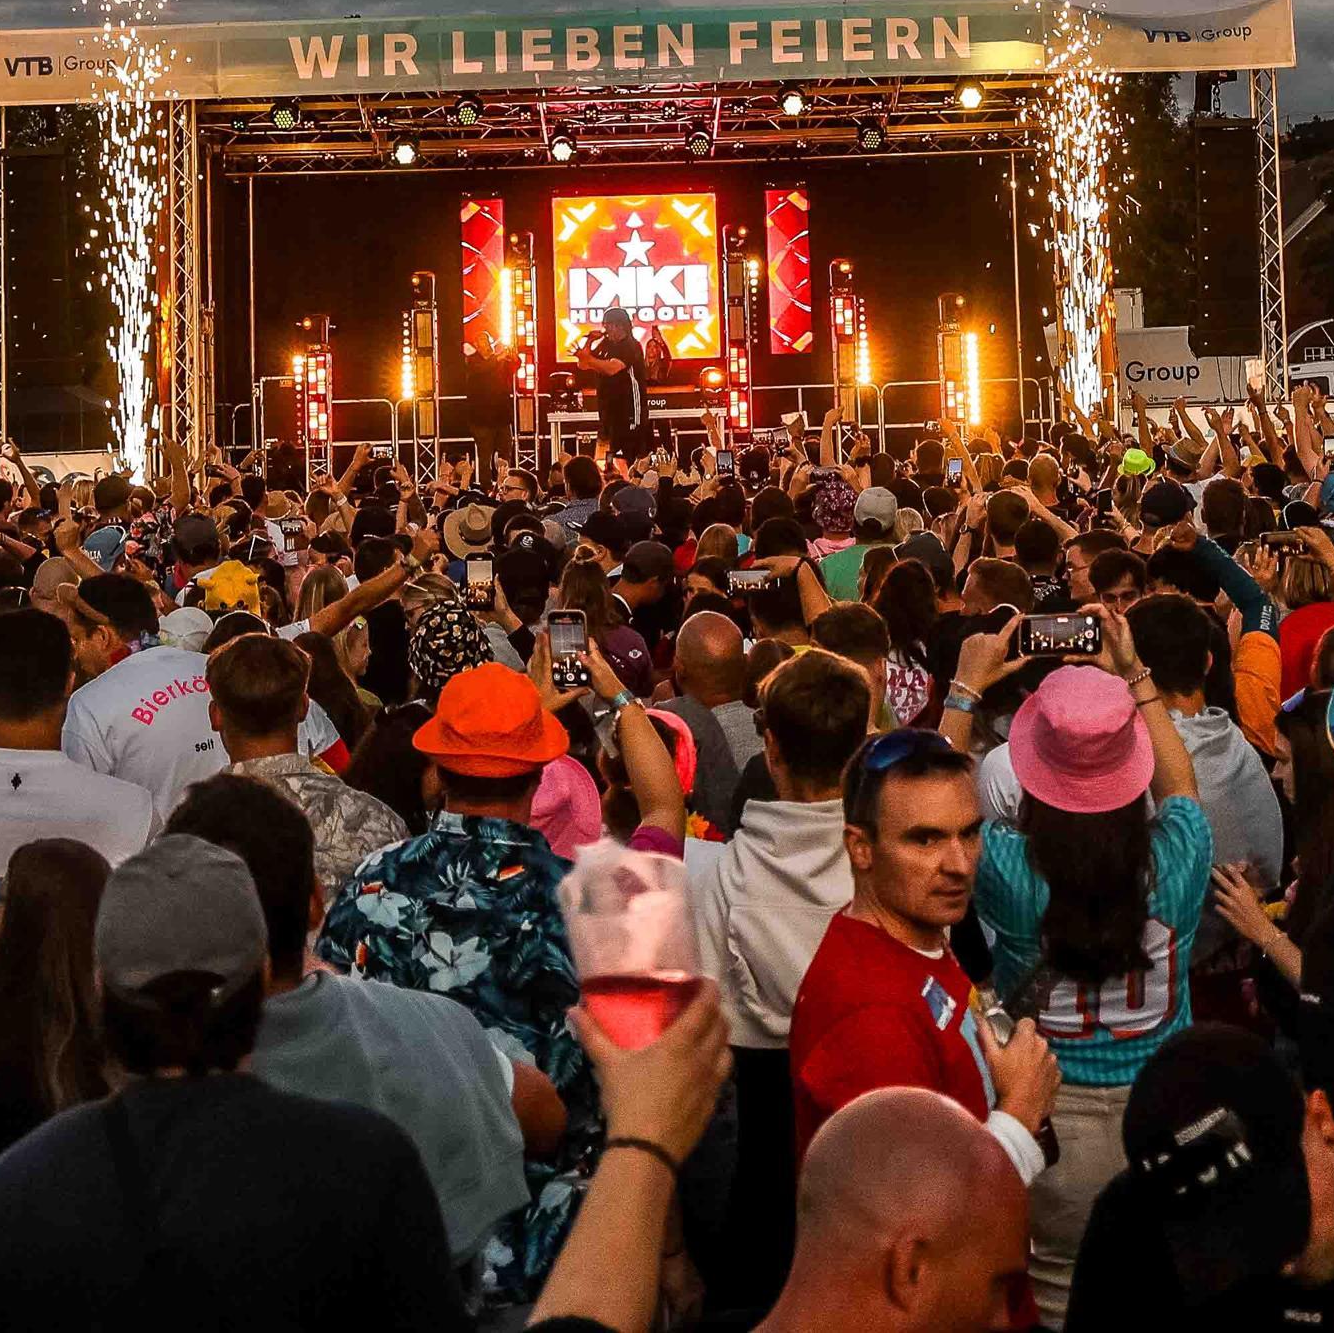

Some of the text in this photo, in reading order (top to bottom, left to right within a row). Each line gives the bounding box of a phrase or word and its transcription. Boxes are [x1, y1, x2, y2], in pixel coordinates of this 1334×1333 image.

[1142, 26, 1252, 43] VTB Group
[288, 16, 971, 79] WIR LIEBEN FEIERN
[4, 55, 117, 77] VTB Group
[569, 264, 709, 309] IKKE
[570, 305, 709, 324] HUTGOLD
[1125, 361, 1200, 386] Group
[647, 399, 667, 408] roup
[131, 675, 211, 726] Bierkö
[195, 739, 214, 753] seit
